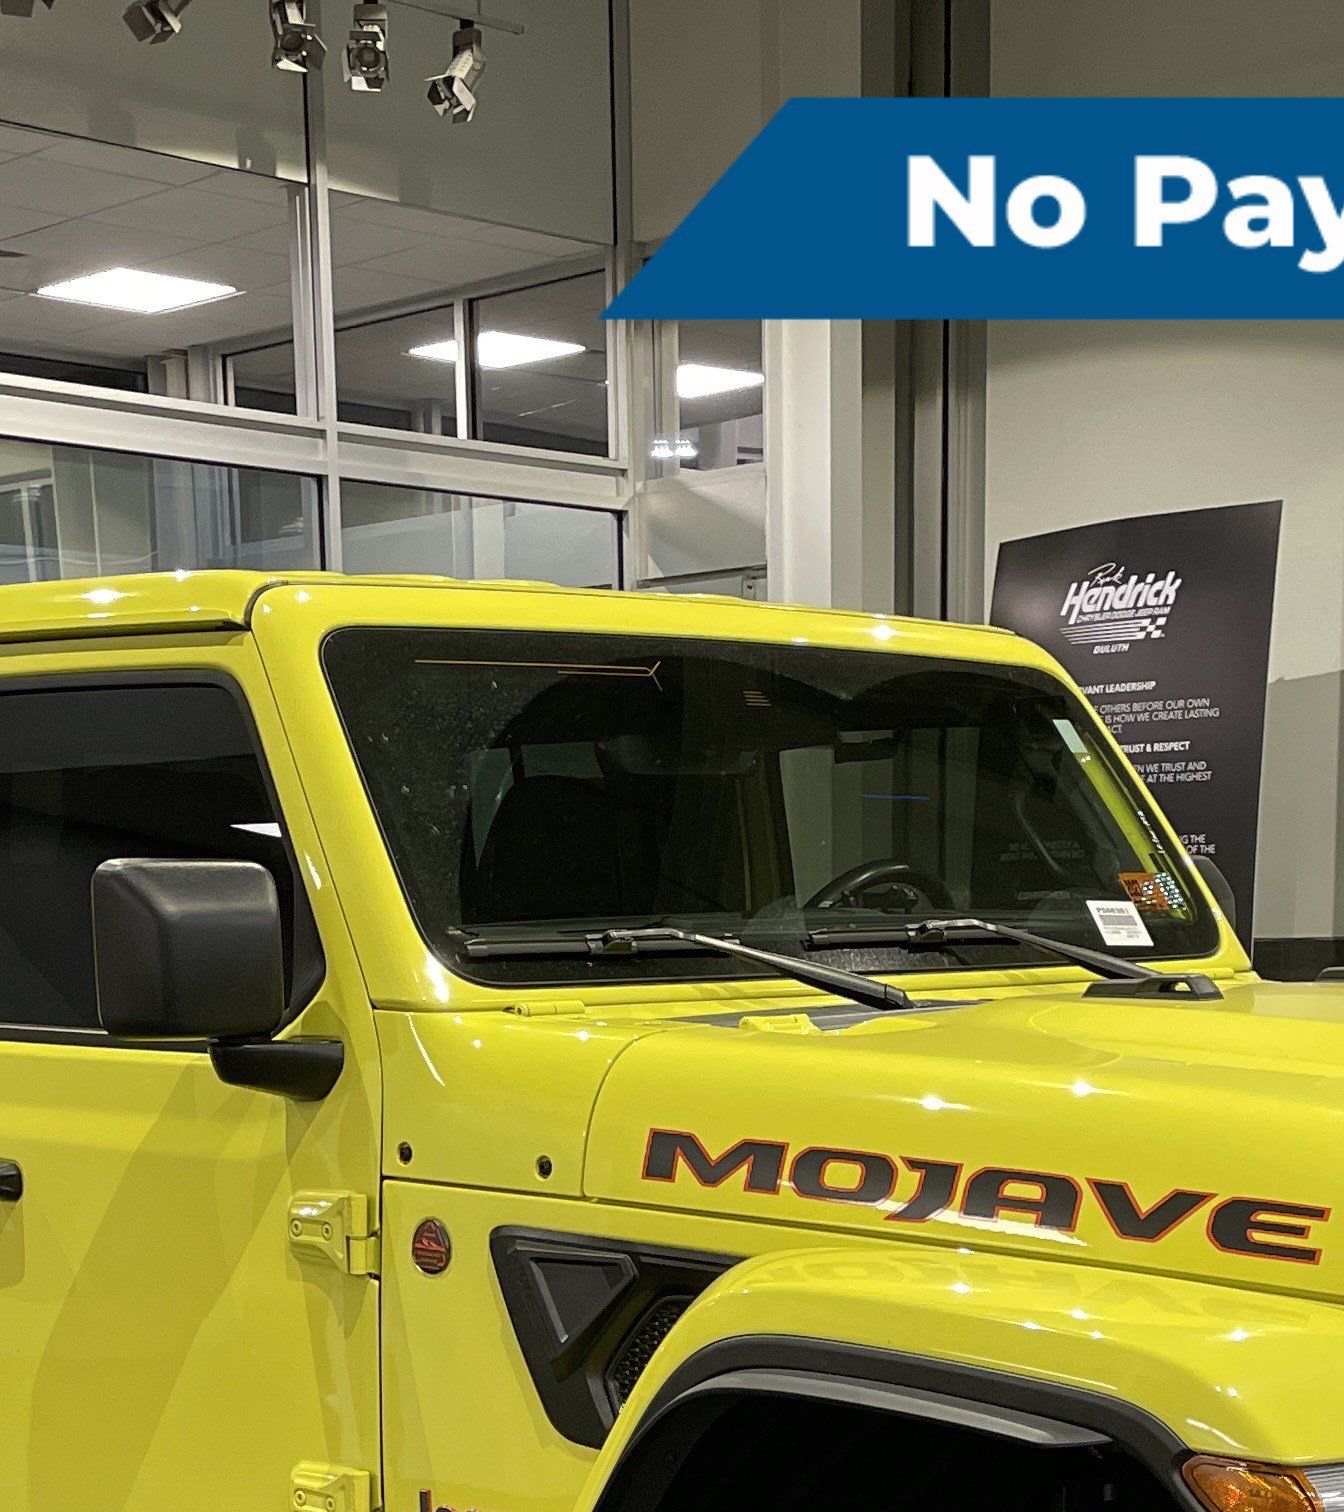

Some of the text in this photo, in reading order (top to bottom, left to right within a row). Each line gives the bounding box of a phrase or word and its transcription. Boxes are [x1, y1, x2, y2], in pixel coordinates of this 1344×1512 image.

[1059, 570, 1182, 625] Hendrick
[1092, 643, 1130, 655] DULUTH
[1105, 681, 1156, 693] LEADERSHIP
[1099, 703, 1131, 714] OTHERS
[1132, 701, 1164, 712] BEFORE
[1165, 700, 1185, 710] OUR
[1186, 698, 1210, 708] OWN
[1113, 714, 1135, 723] HOW
[1136, 713, 1150, 722] WE
[1152, 711, 1183, 720] CREATE
[1184, 708, 1220, 719] LASTING
[1146, 743, 1152, 752] &
[1153, 741, 1190, 752] RESPECT
[1146, 763, 1159, 773] WE
[1161, 762, 1185, 772] TRUST
[1187, 761, 1207, 771] AND
[1146, 774, 1157, 783] AT
[1159, 773, 1174, 783] THE
[1176, 771, 1212, 782] HIGHEST
[1190, 834, 1206, 844] THE
[1187, 844, 1216, 854] OF THE
[642, 1127, 1332, 1266] MOJAVE
